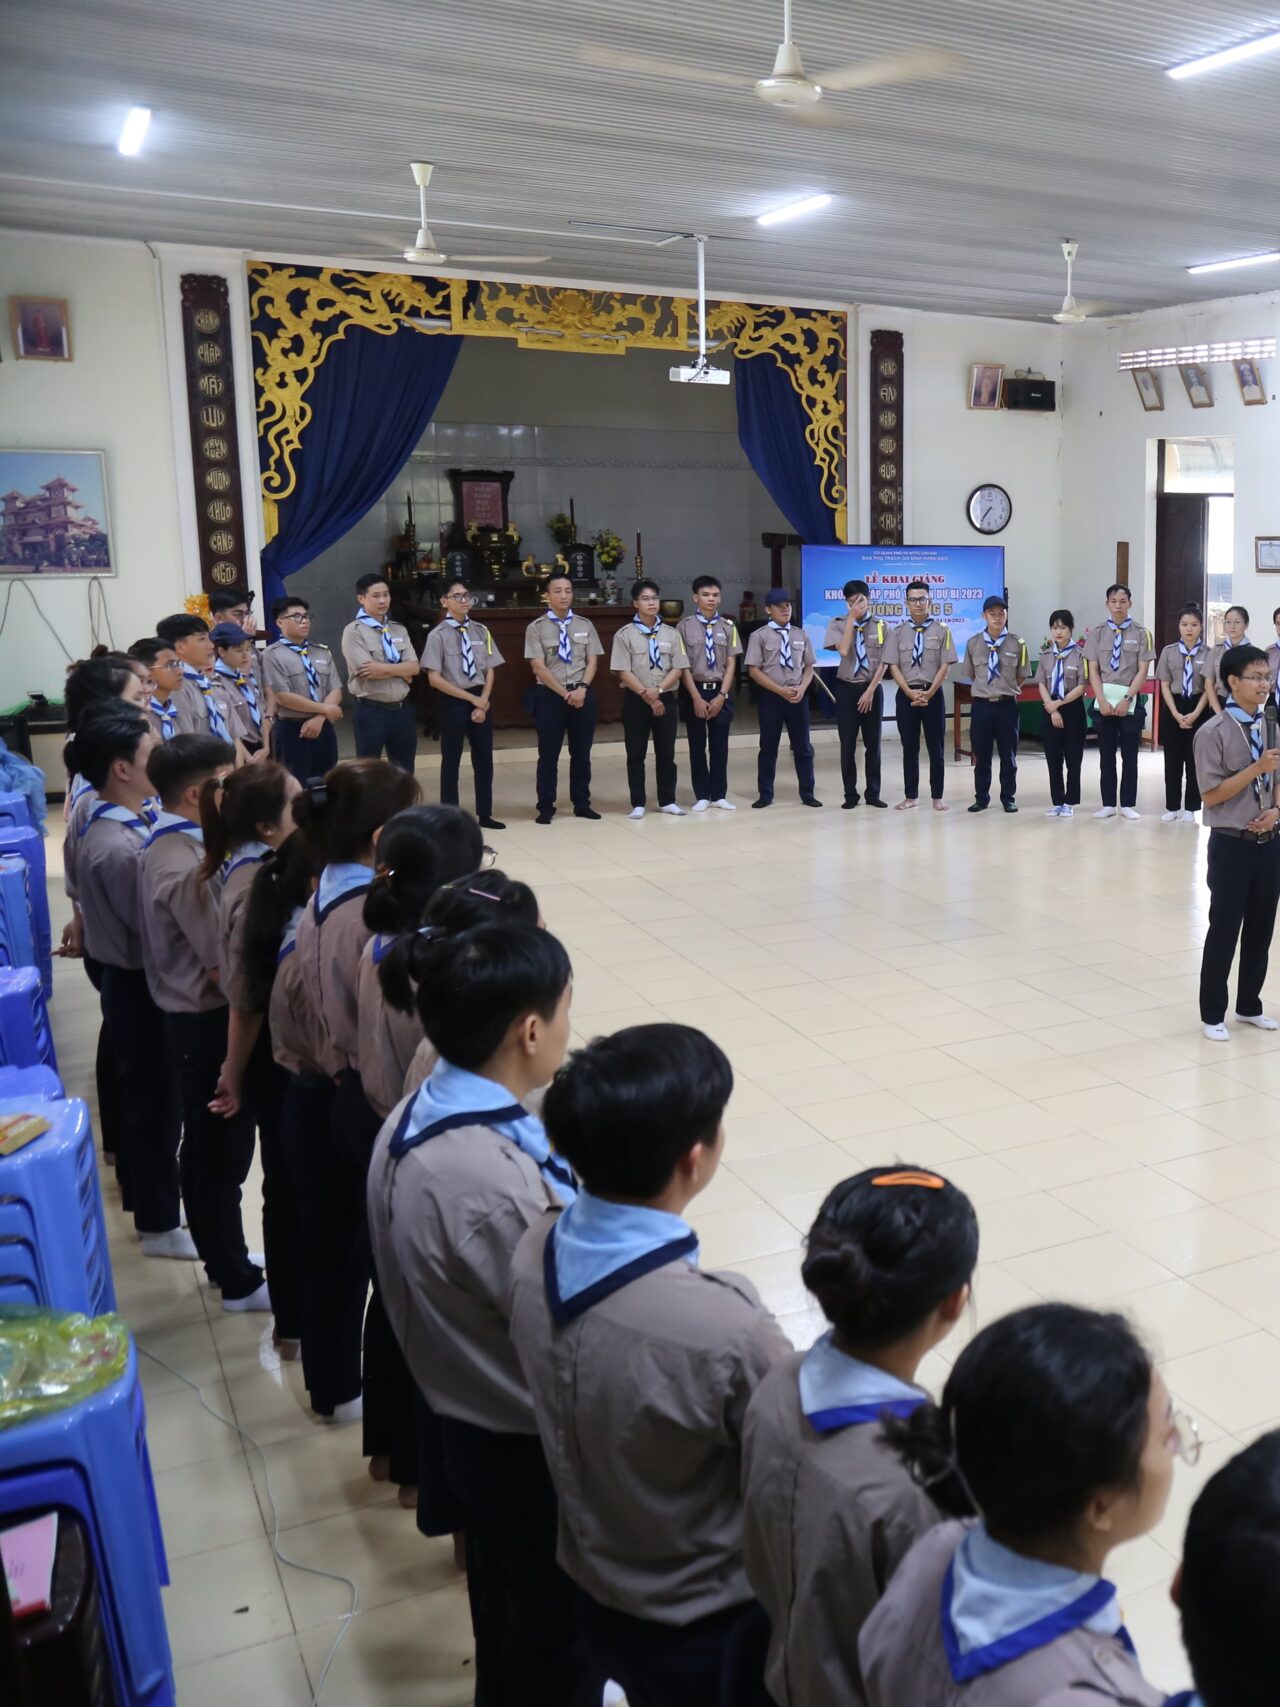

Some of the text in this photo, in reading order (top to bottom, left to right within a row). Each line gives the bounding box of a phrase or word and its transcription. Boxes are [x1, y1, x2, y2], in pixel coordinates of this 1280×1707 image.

[198, 343, 221, 364] PHÁP
[200, 374, 223, 396] MÃI
[865, 572, 878, 584] LỄ
[882, 576, 909, 584] KHAI
[825, 587, 846, 600] KHÓ
[961, 589, 983, 599] 2023
[944, 603, 953, 616] 5
